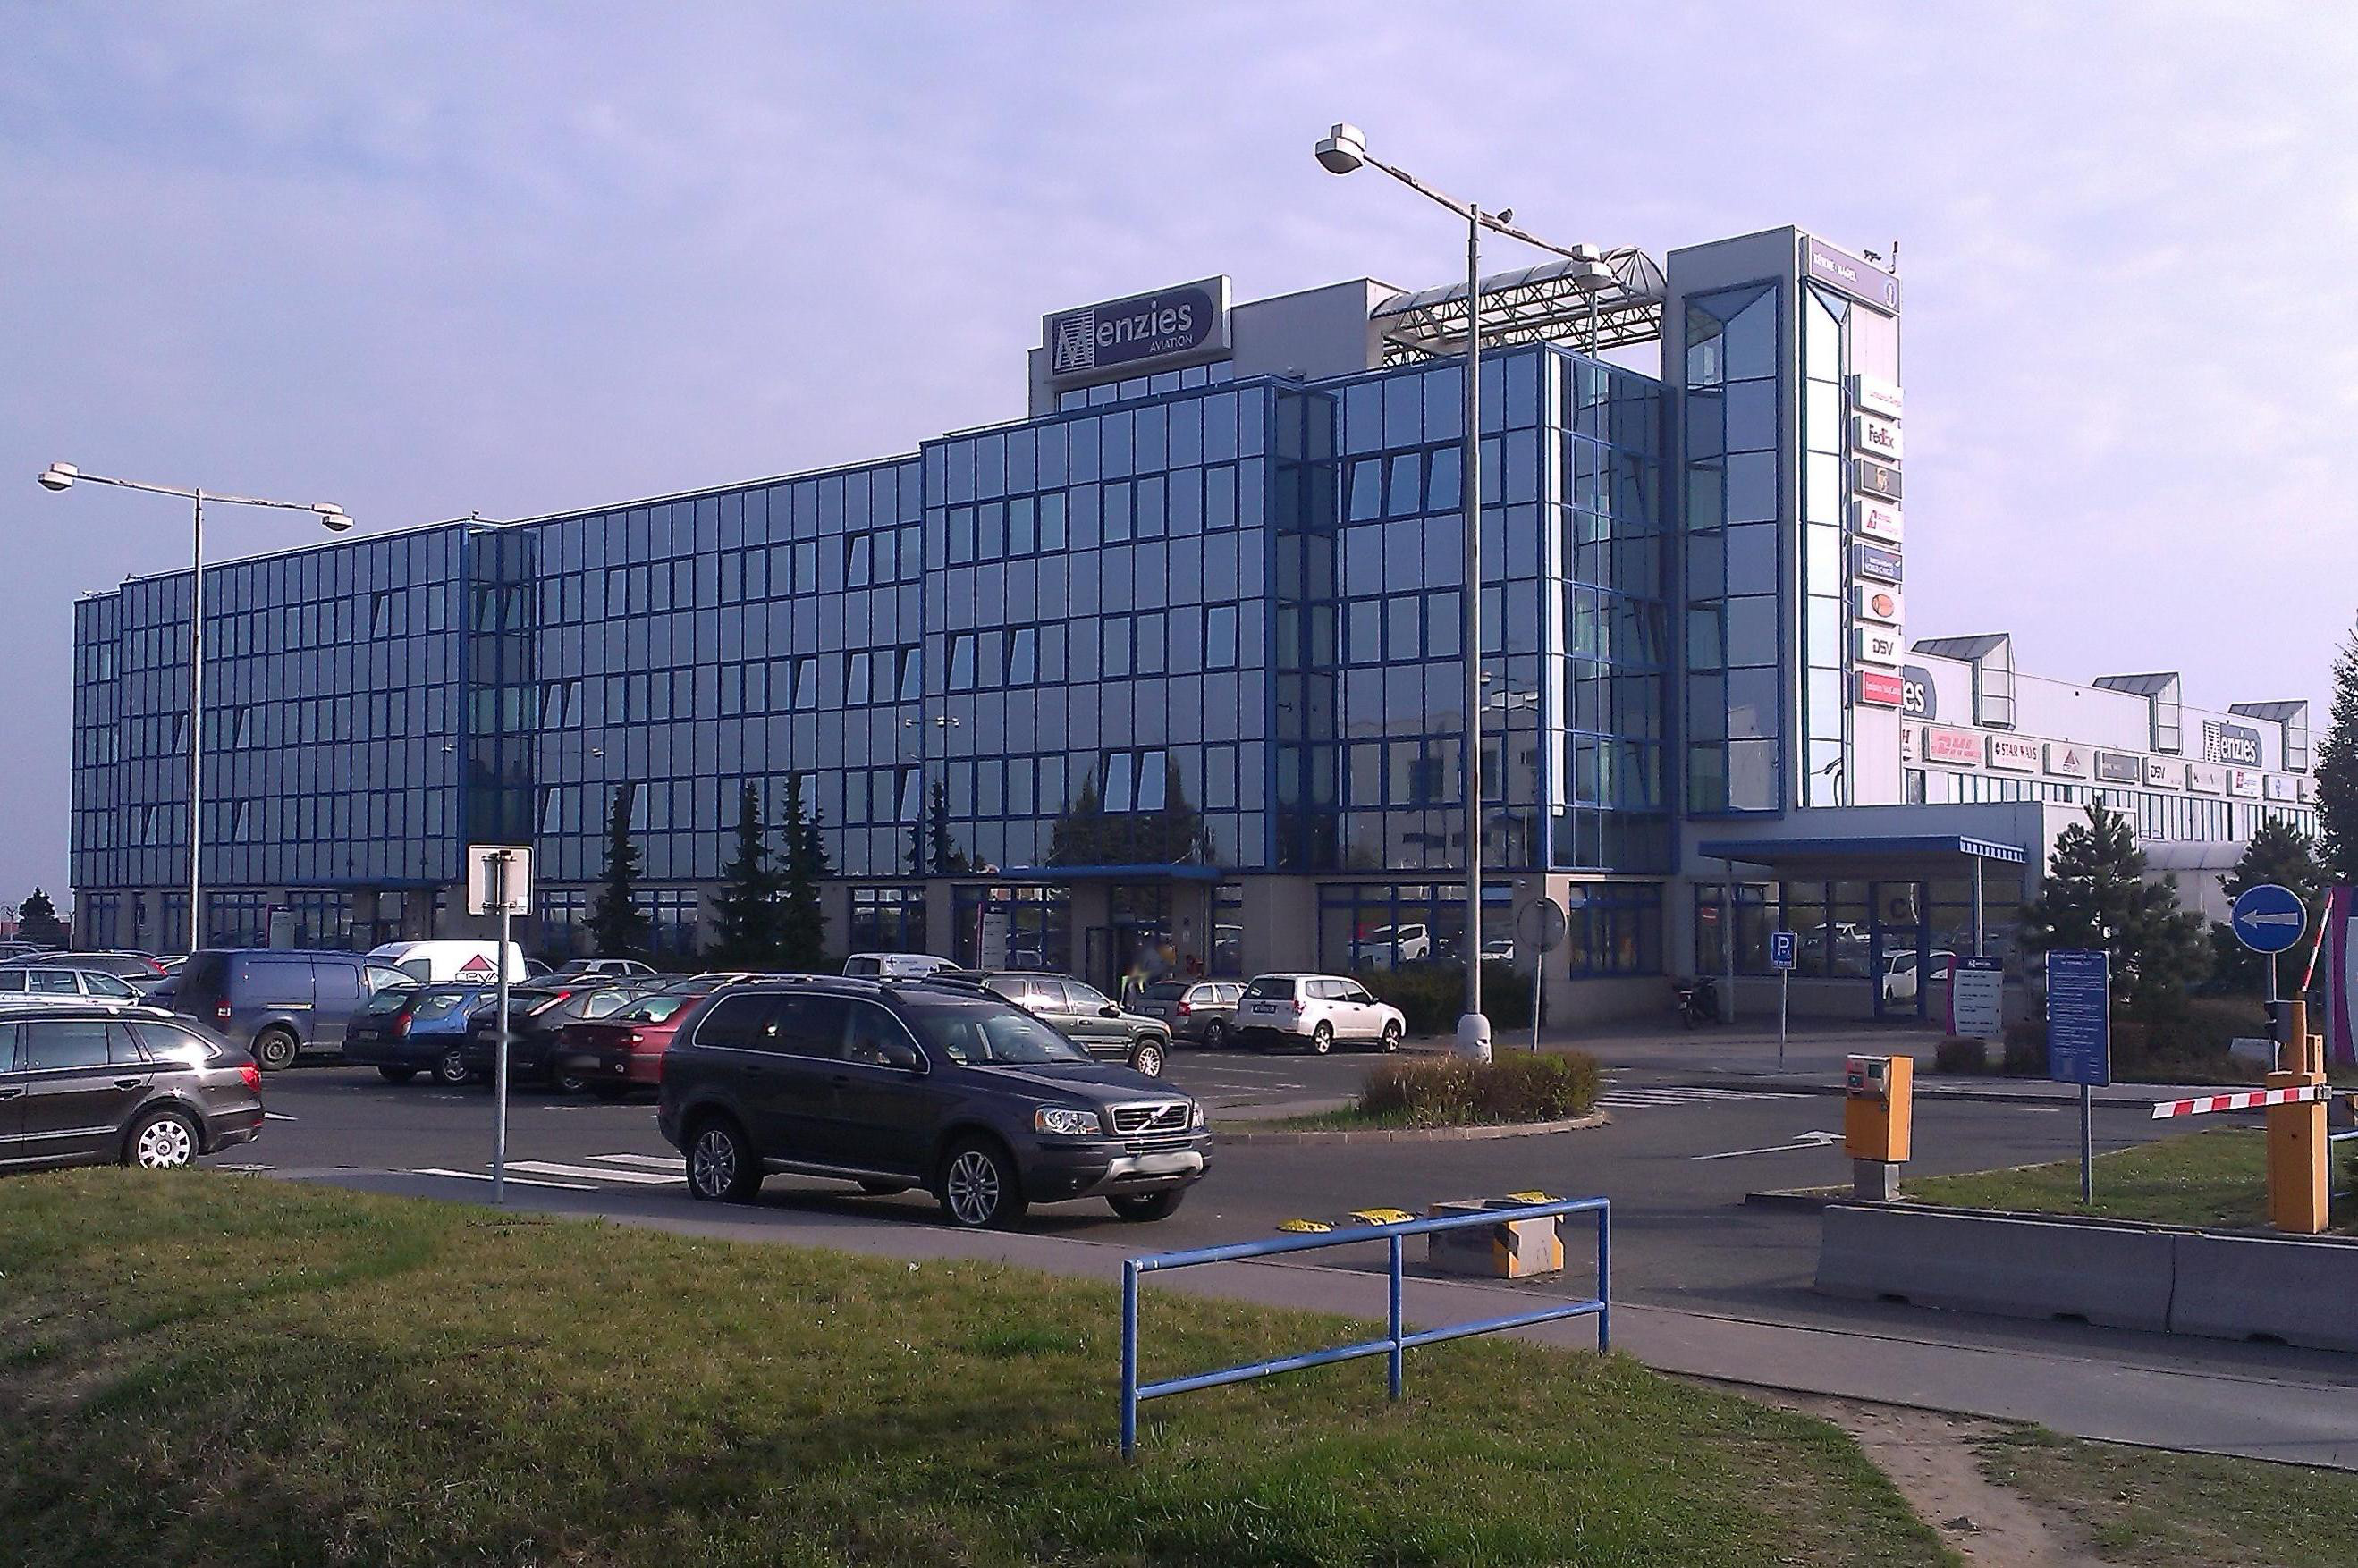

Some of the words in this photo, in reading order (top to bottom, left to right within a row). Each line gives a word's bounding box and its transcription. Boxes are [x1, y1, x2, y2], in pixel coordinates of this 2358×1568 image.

[1053, 300, 1192, 372] Menzies
[1150, 334, 1193, 353] AVIATION
[1872, 637, 1894, 656] DSV
[2001, 742, 2018, 757] STAR
[2151, 765, 2166, 780] DSV
[1778, 936, 1789, 956] P
